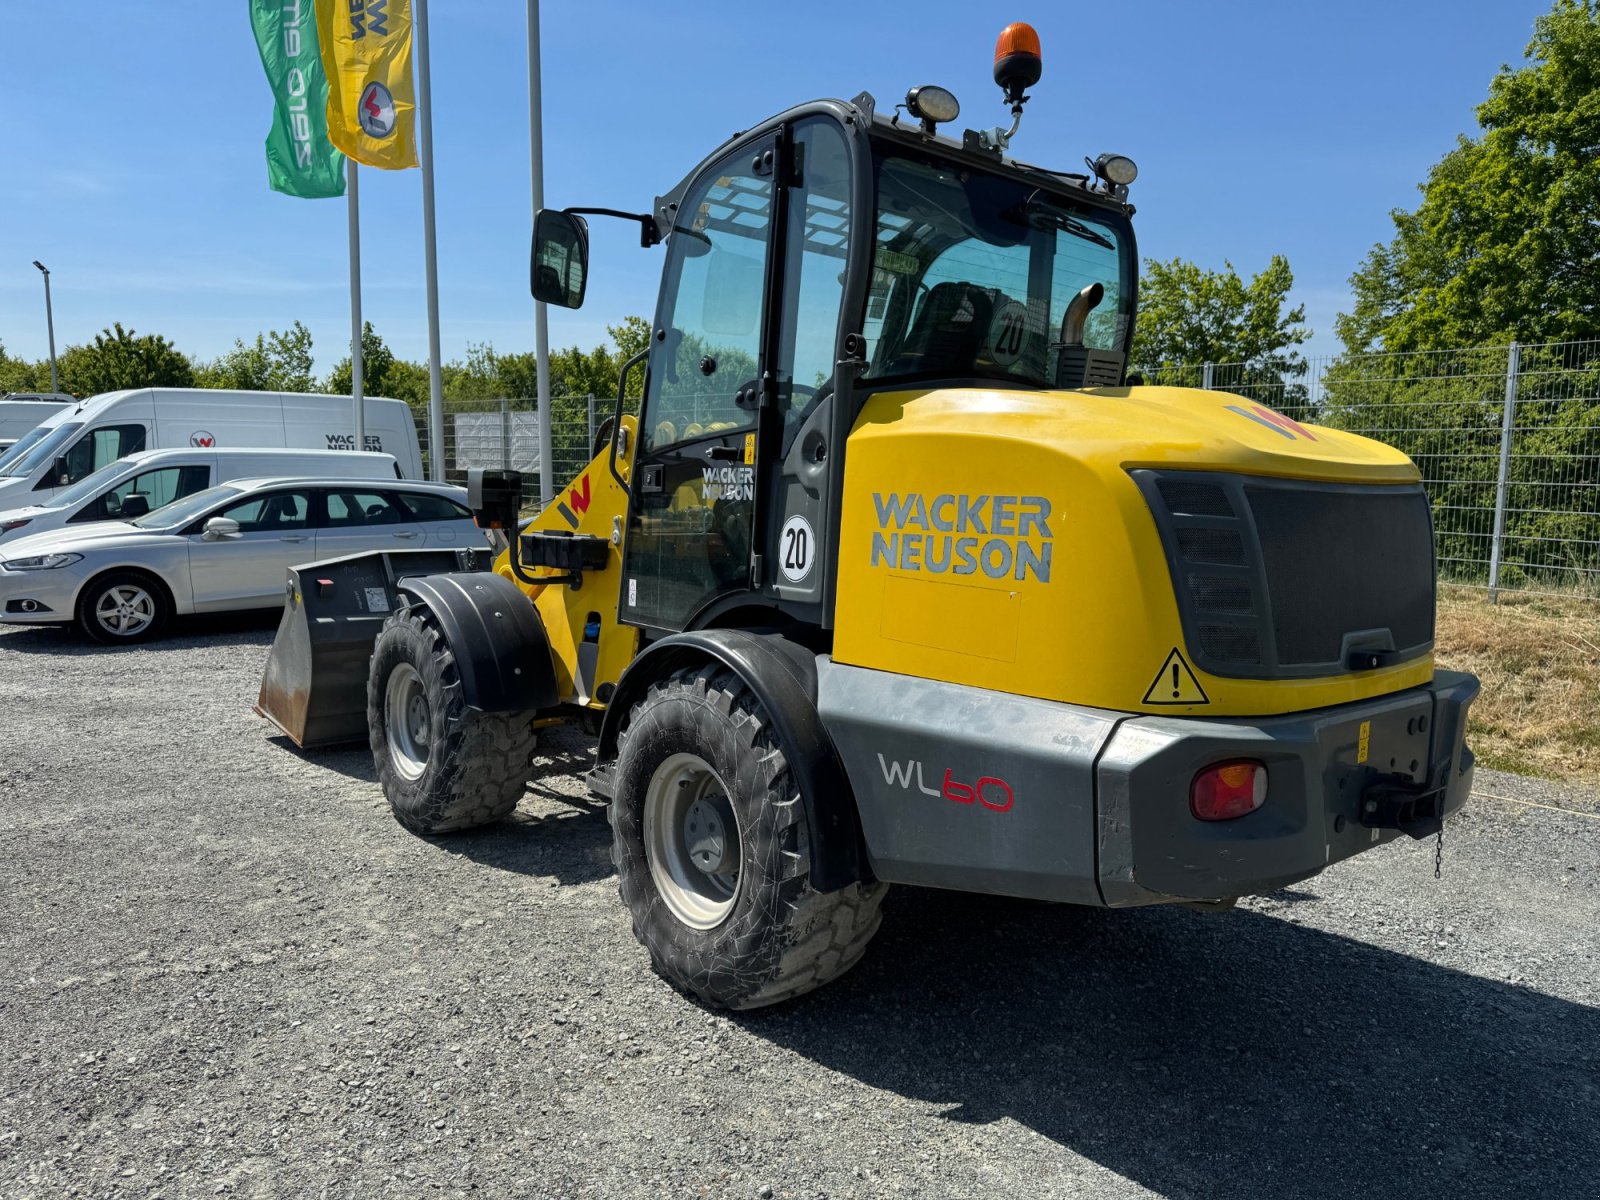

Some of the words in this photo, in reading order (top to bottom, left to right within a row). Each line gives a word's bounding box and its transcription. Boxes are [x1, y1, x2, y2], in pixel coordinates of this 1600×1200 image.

[995, 312, 1024, 355] 20
[325, 434, 381, 444] WACER
[327, 444, 382, 452] NEUON
[702, 467, 754, 483] WACKER
[702, 483, 754, 500] NEUSON
[872, 492, 1053, 538] WACKER
[785, 527, 807, 569] 20
[870, 531, 1053, 583] NEUSON
